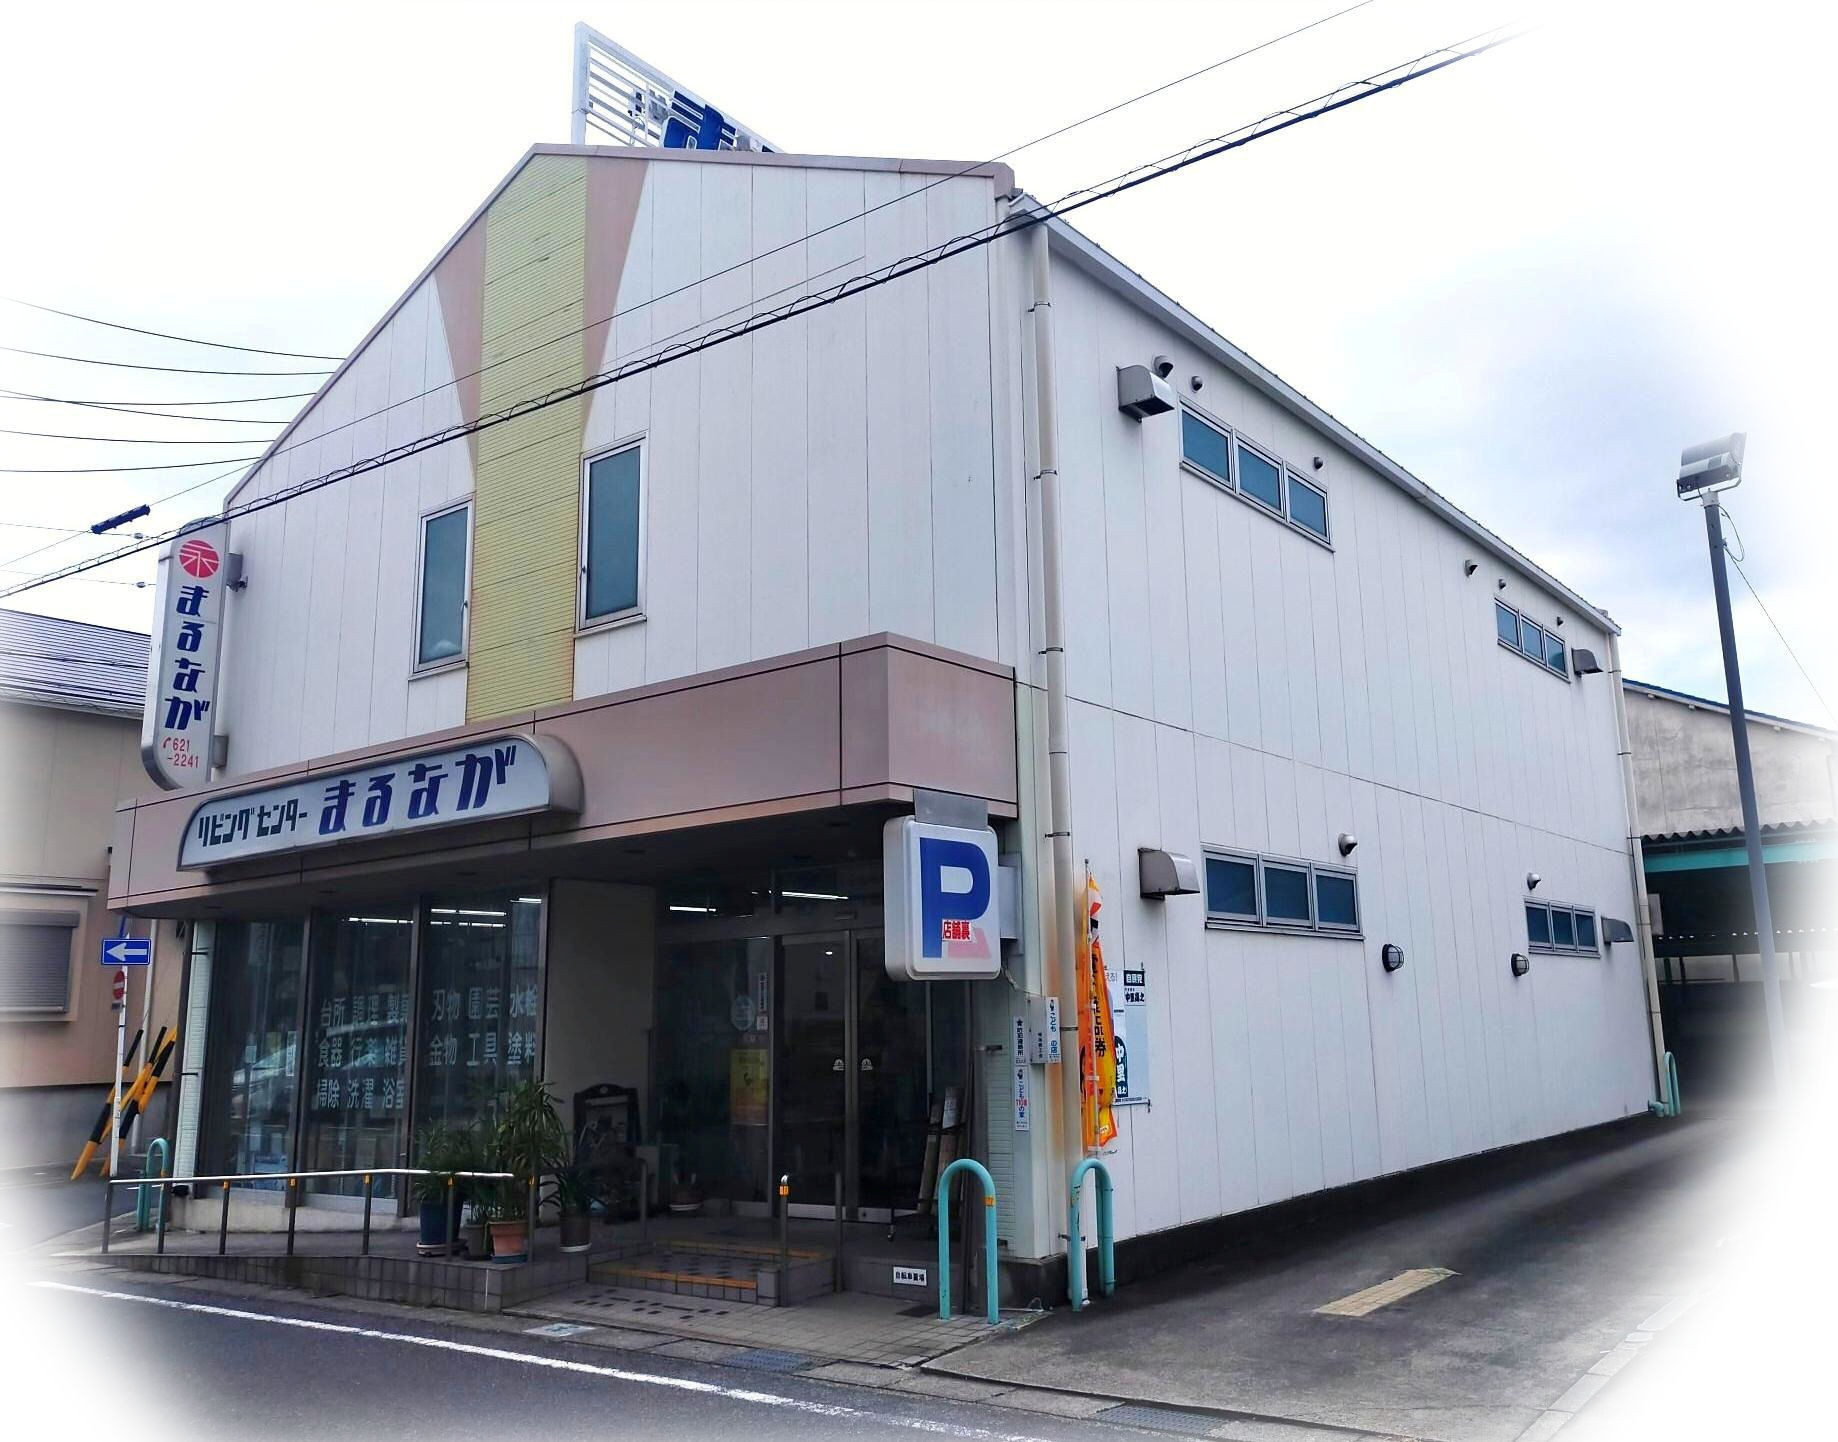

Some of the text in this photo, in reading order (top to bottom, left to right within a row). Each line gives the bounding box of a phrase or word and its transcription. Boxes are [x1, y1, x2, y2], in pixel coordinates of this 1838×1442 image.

[165, 585, 211, 731] まるなが
[172, 739, 190, 752] 621
[319, 744, 517, 835] まるなが
[920, 837, 990, 958] P
[943, 919, 971, 940] 店舗裏
[320, 997, 346, 1028] 台所
[431, 988, 461, 1022] 刃物
[468, 986, 501, 1021] 園芸
[318, 1039, 344, 1068] 食器
[430, 1031, 536, 1067] 金物 工具 塗料
[317, 1080, 341, 1109] 掃除
[347, 1079, 375, 1109] 洗濯
